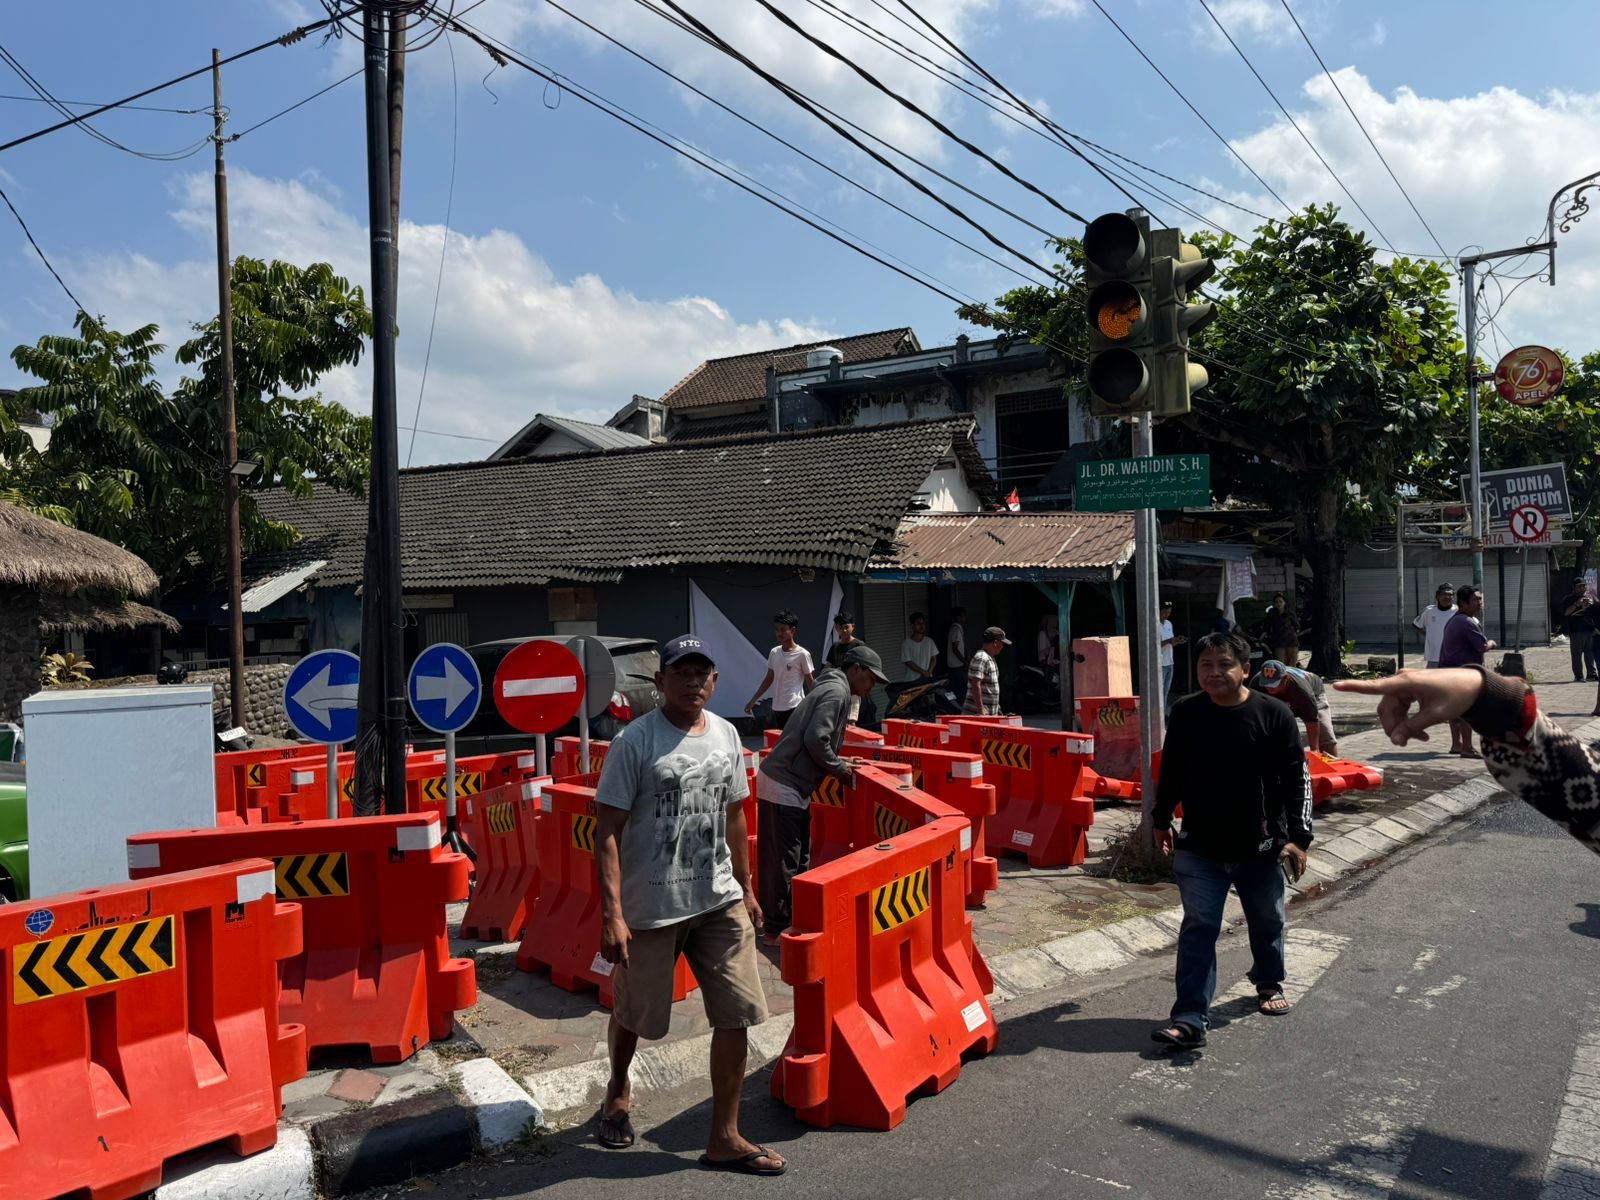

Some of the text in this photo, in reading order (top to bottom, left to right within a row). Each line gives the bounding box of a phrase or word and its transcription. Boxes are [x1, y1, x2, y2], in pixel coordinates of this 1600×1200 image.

[1515, 390, 1545, 400] APEL
[1080, 464, 1096, 478] JL.
[1100, 462, 1119, 476] DR.
[1121, 458, 1174, 475] WAHIDIN
[1505, 474, 1553, 494] DUNIA
[1501, 490, 1563, 511] PARFUM
[679, 639, 701, 648] NYC
